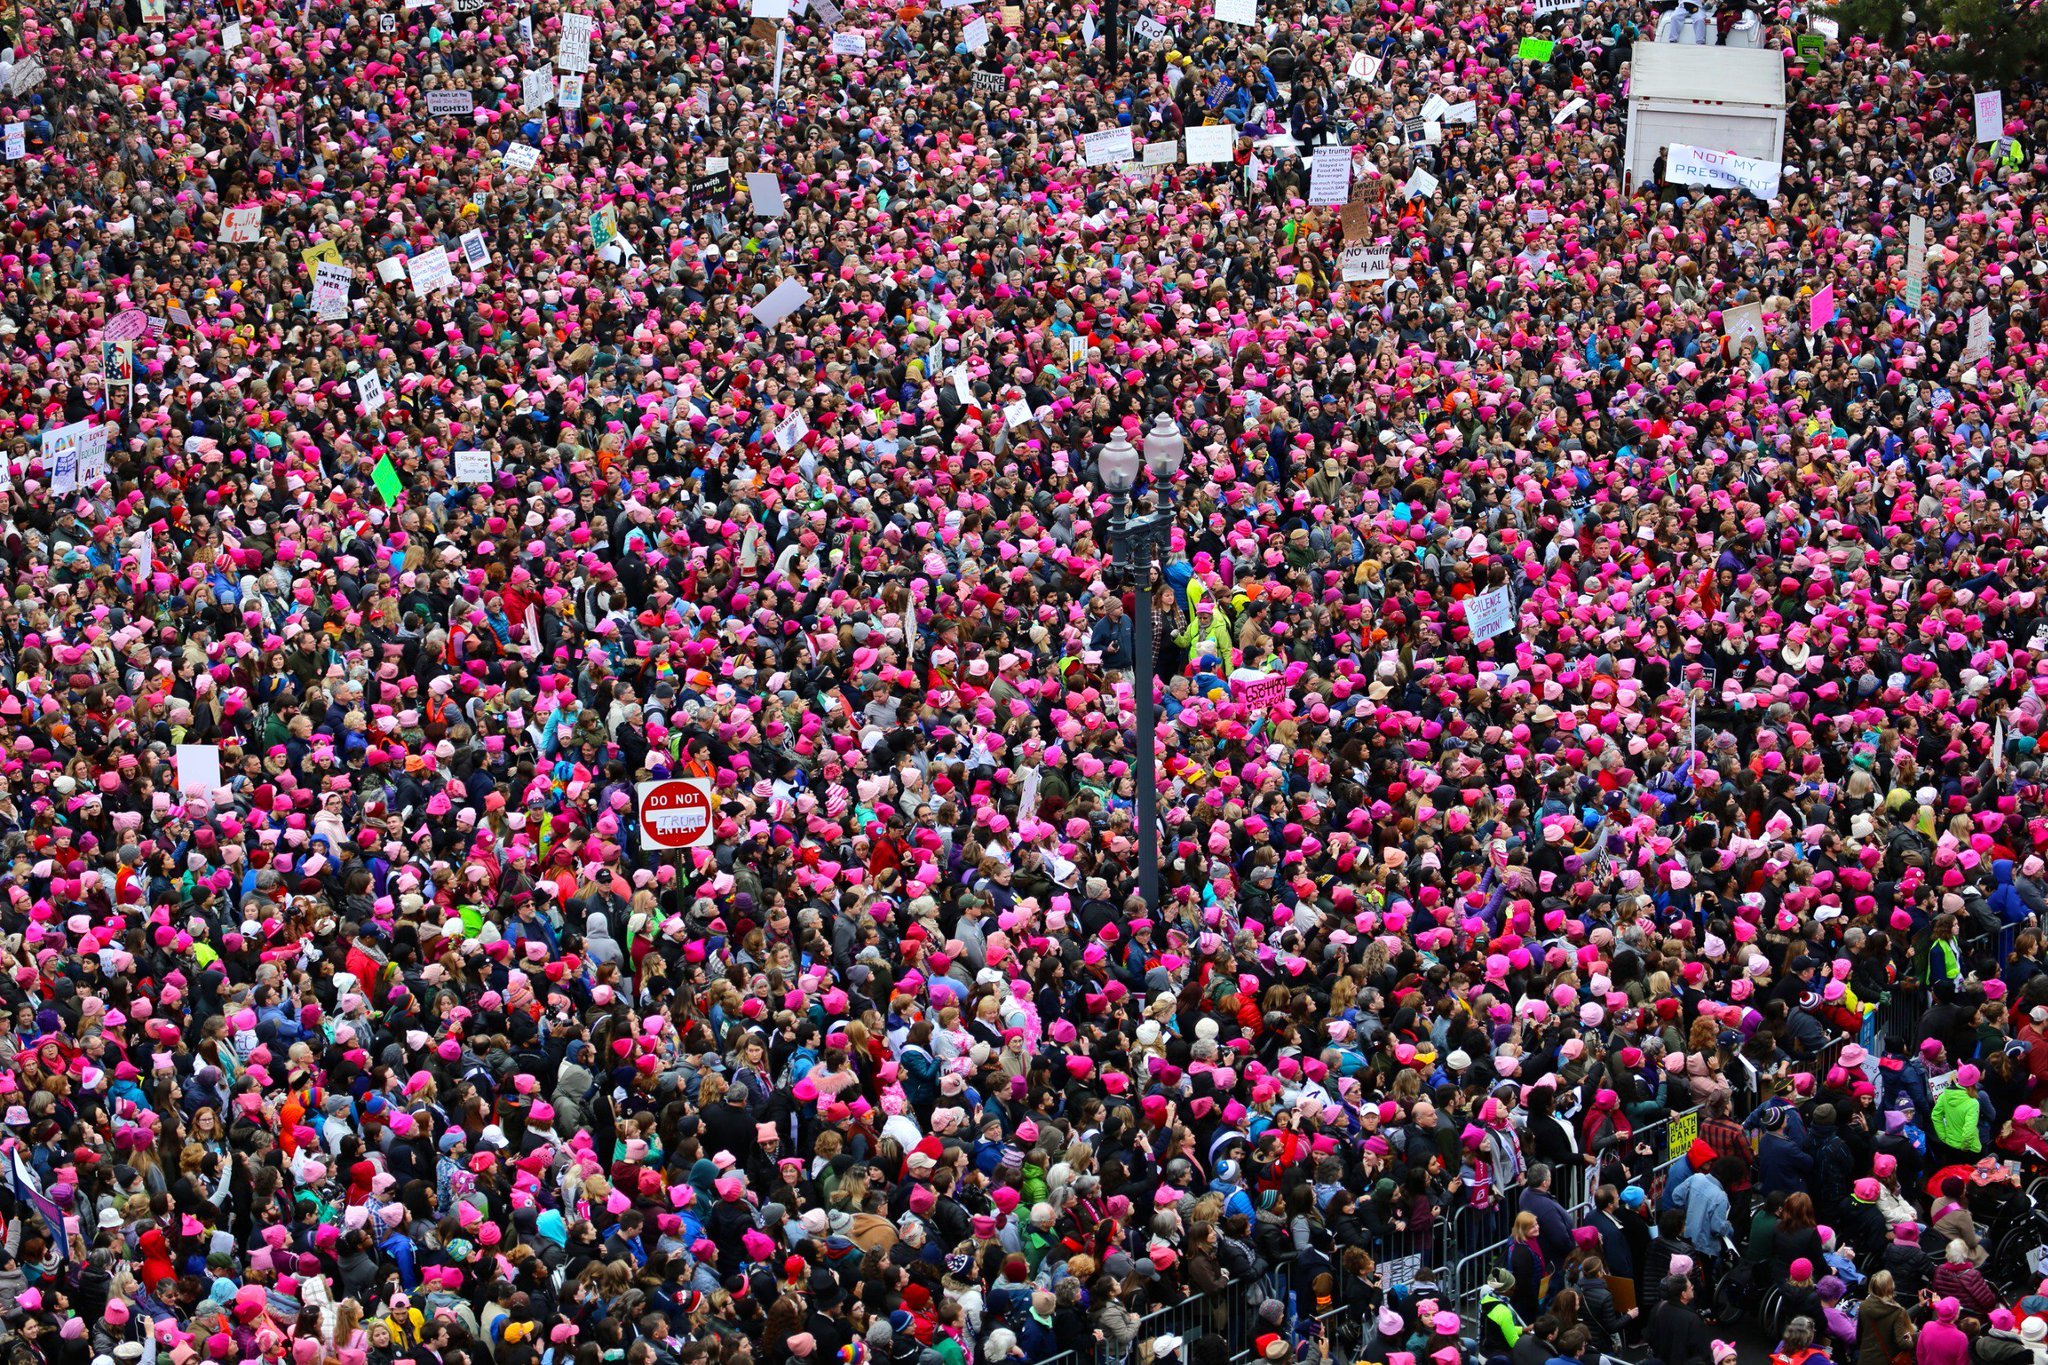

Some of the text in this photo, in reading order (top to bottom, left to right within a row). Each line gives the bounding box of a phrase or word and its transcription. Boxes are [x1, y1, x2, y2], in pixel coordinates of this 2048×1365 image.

[568, 15, 588, 27] KEEP
[972, 71, 1005, 85] FUTURE
[1313, 148, 1326, 156] Hey
[1692, 150, 1757, 171] NOT MY
[1675, 164, 1772, 191] PRESIDENT
[692, 177, 720, 193] I'm with
[713, 184, 727, 195] her
[225, 212, 261, 230] Equality
[1346, 248, 1361, 258] NO
[1360, 260, 1385, 273] 4 All
[317, 269, 350, 283] IM WITH
[323, 280, 340, 290] HER
[364, 378, 374, 392] NOT
[773, 410, 800, 435] FORWARD
[89, 431, 105, 441] LOVE
[44, 434, 76, 459] LOV
[81, 445, 105, 460] EQUALITY
[84, 467, 101, 482] ALL
[1470, 592, 1501, 614] SILENCE
[1482, 610, 1491, 618] NOT
[1477, 617, 1503, 639] OPTION!
[1253, 701, 1264, 709] YES
[650, 792, 700, 807] DO NOT
[659, 814, 704, 827] TRUMP
[1670, 1116, 1696, 1134] HEALTH
[1670, 1125, 1696, 1143] CARE
